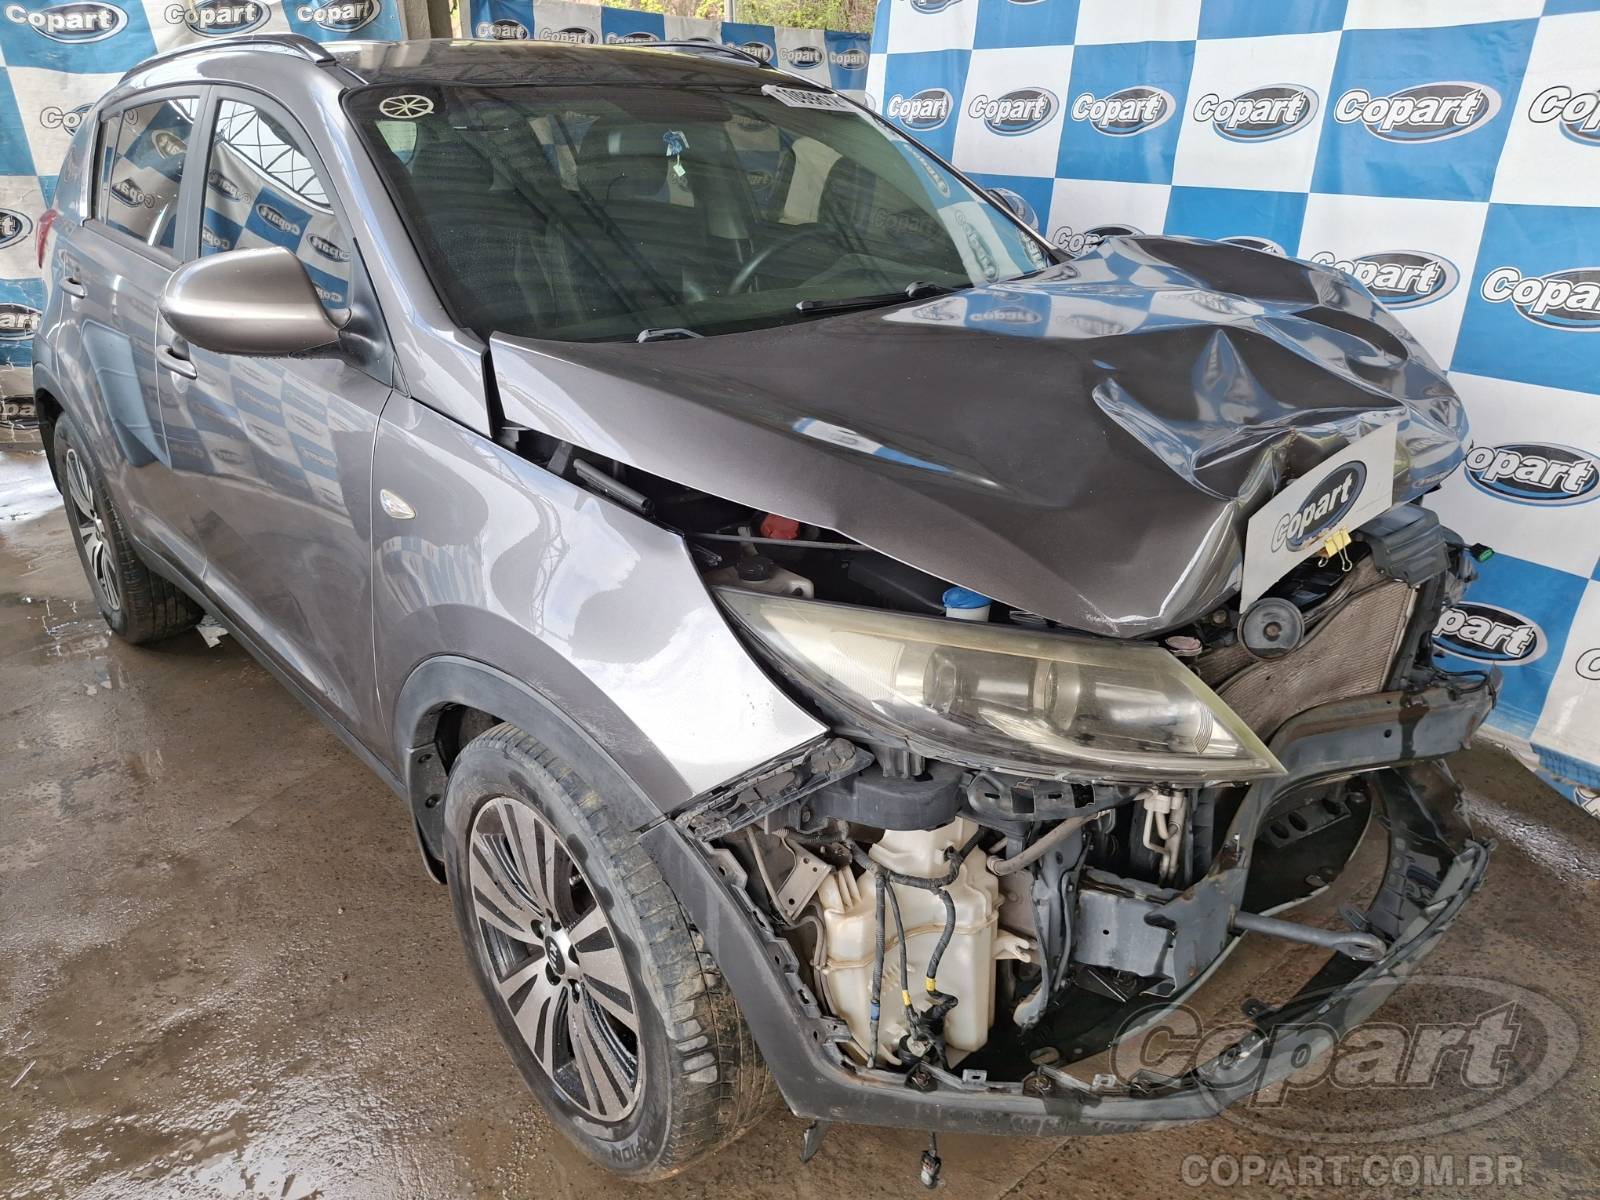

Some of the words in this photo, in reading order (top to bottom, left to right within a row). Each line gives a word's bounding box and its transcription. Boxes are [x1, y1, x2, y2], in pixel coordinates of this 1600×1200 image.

[5, 3, 114, 32] Copart
[163, 3, 258, 30] Copart
[475, 21, 526, 40] Copart
[780, 47, 821, 64] Copart
[829, 50, 866, 67] Copart
[888, 93, 948, 122] Copart
[967, 93, 1048, 128] Copart
[1071, 93, 1162, 129] Copart
[1193, 91, 1306, 130] Copart
[1334, 88, 1486, 132] Copart
[1482, 267, 1600, 315] Copa
[0, 313, 41, 331] art
[1466, 446, 1592, 494] opart
[1271, 472, 1353, 553] Copart
[1431, 606, 1536, 658] part
